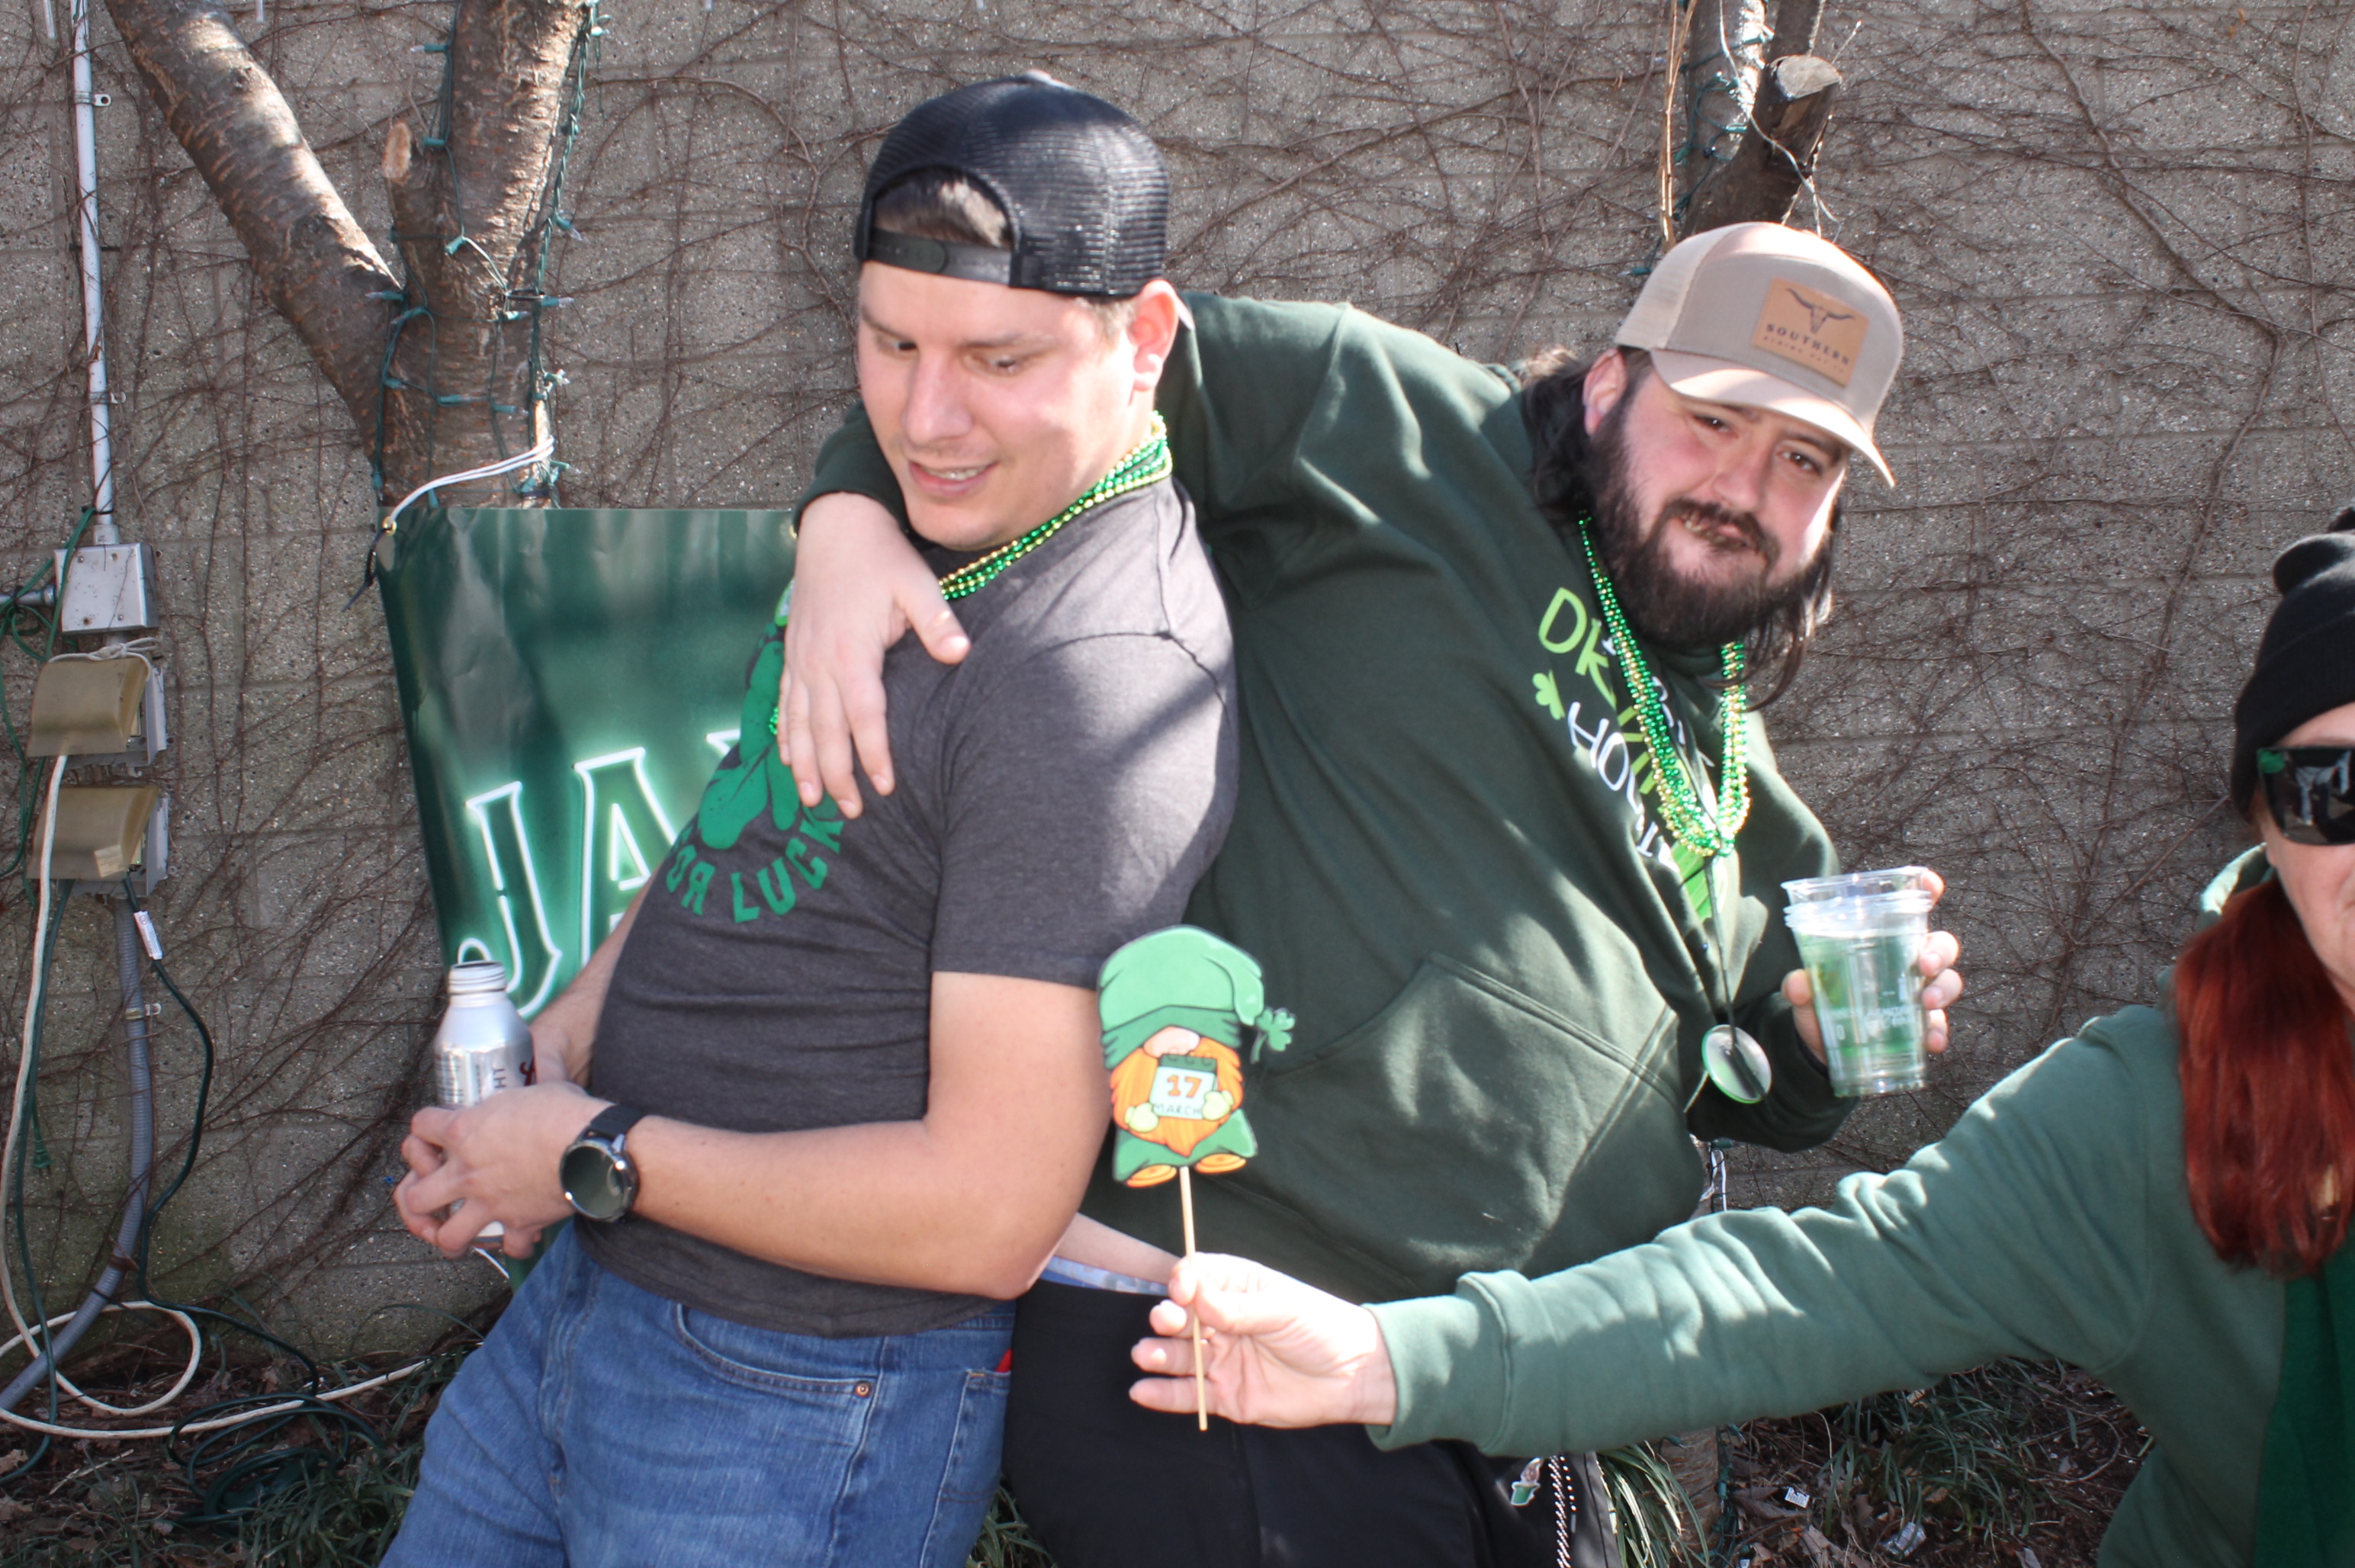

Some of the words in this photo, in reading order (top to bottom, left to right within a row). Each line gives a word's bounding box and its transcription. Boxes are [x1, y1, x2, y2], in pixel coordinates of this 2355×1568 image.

[1766, 323, 1850, 365] SOUTHERN
[458, 728, 741, 1020] JA
[731, 805, 844, 924] LUCK
[1167, 1075, 1203, 1099] 17
